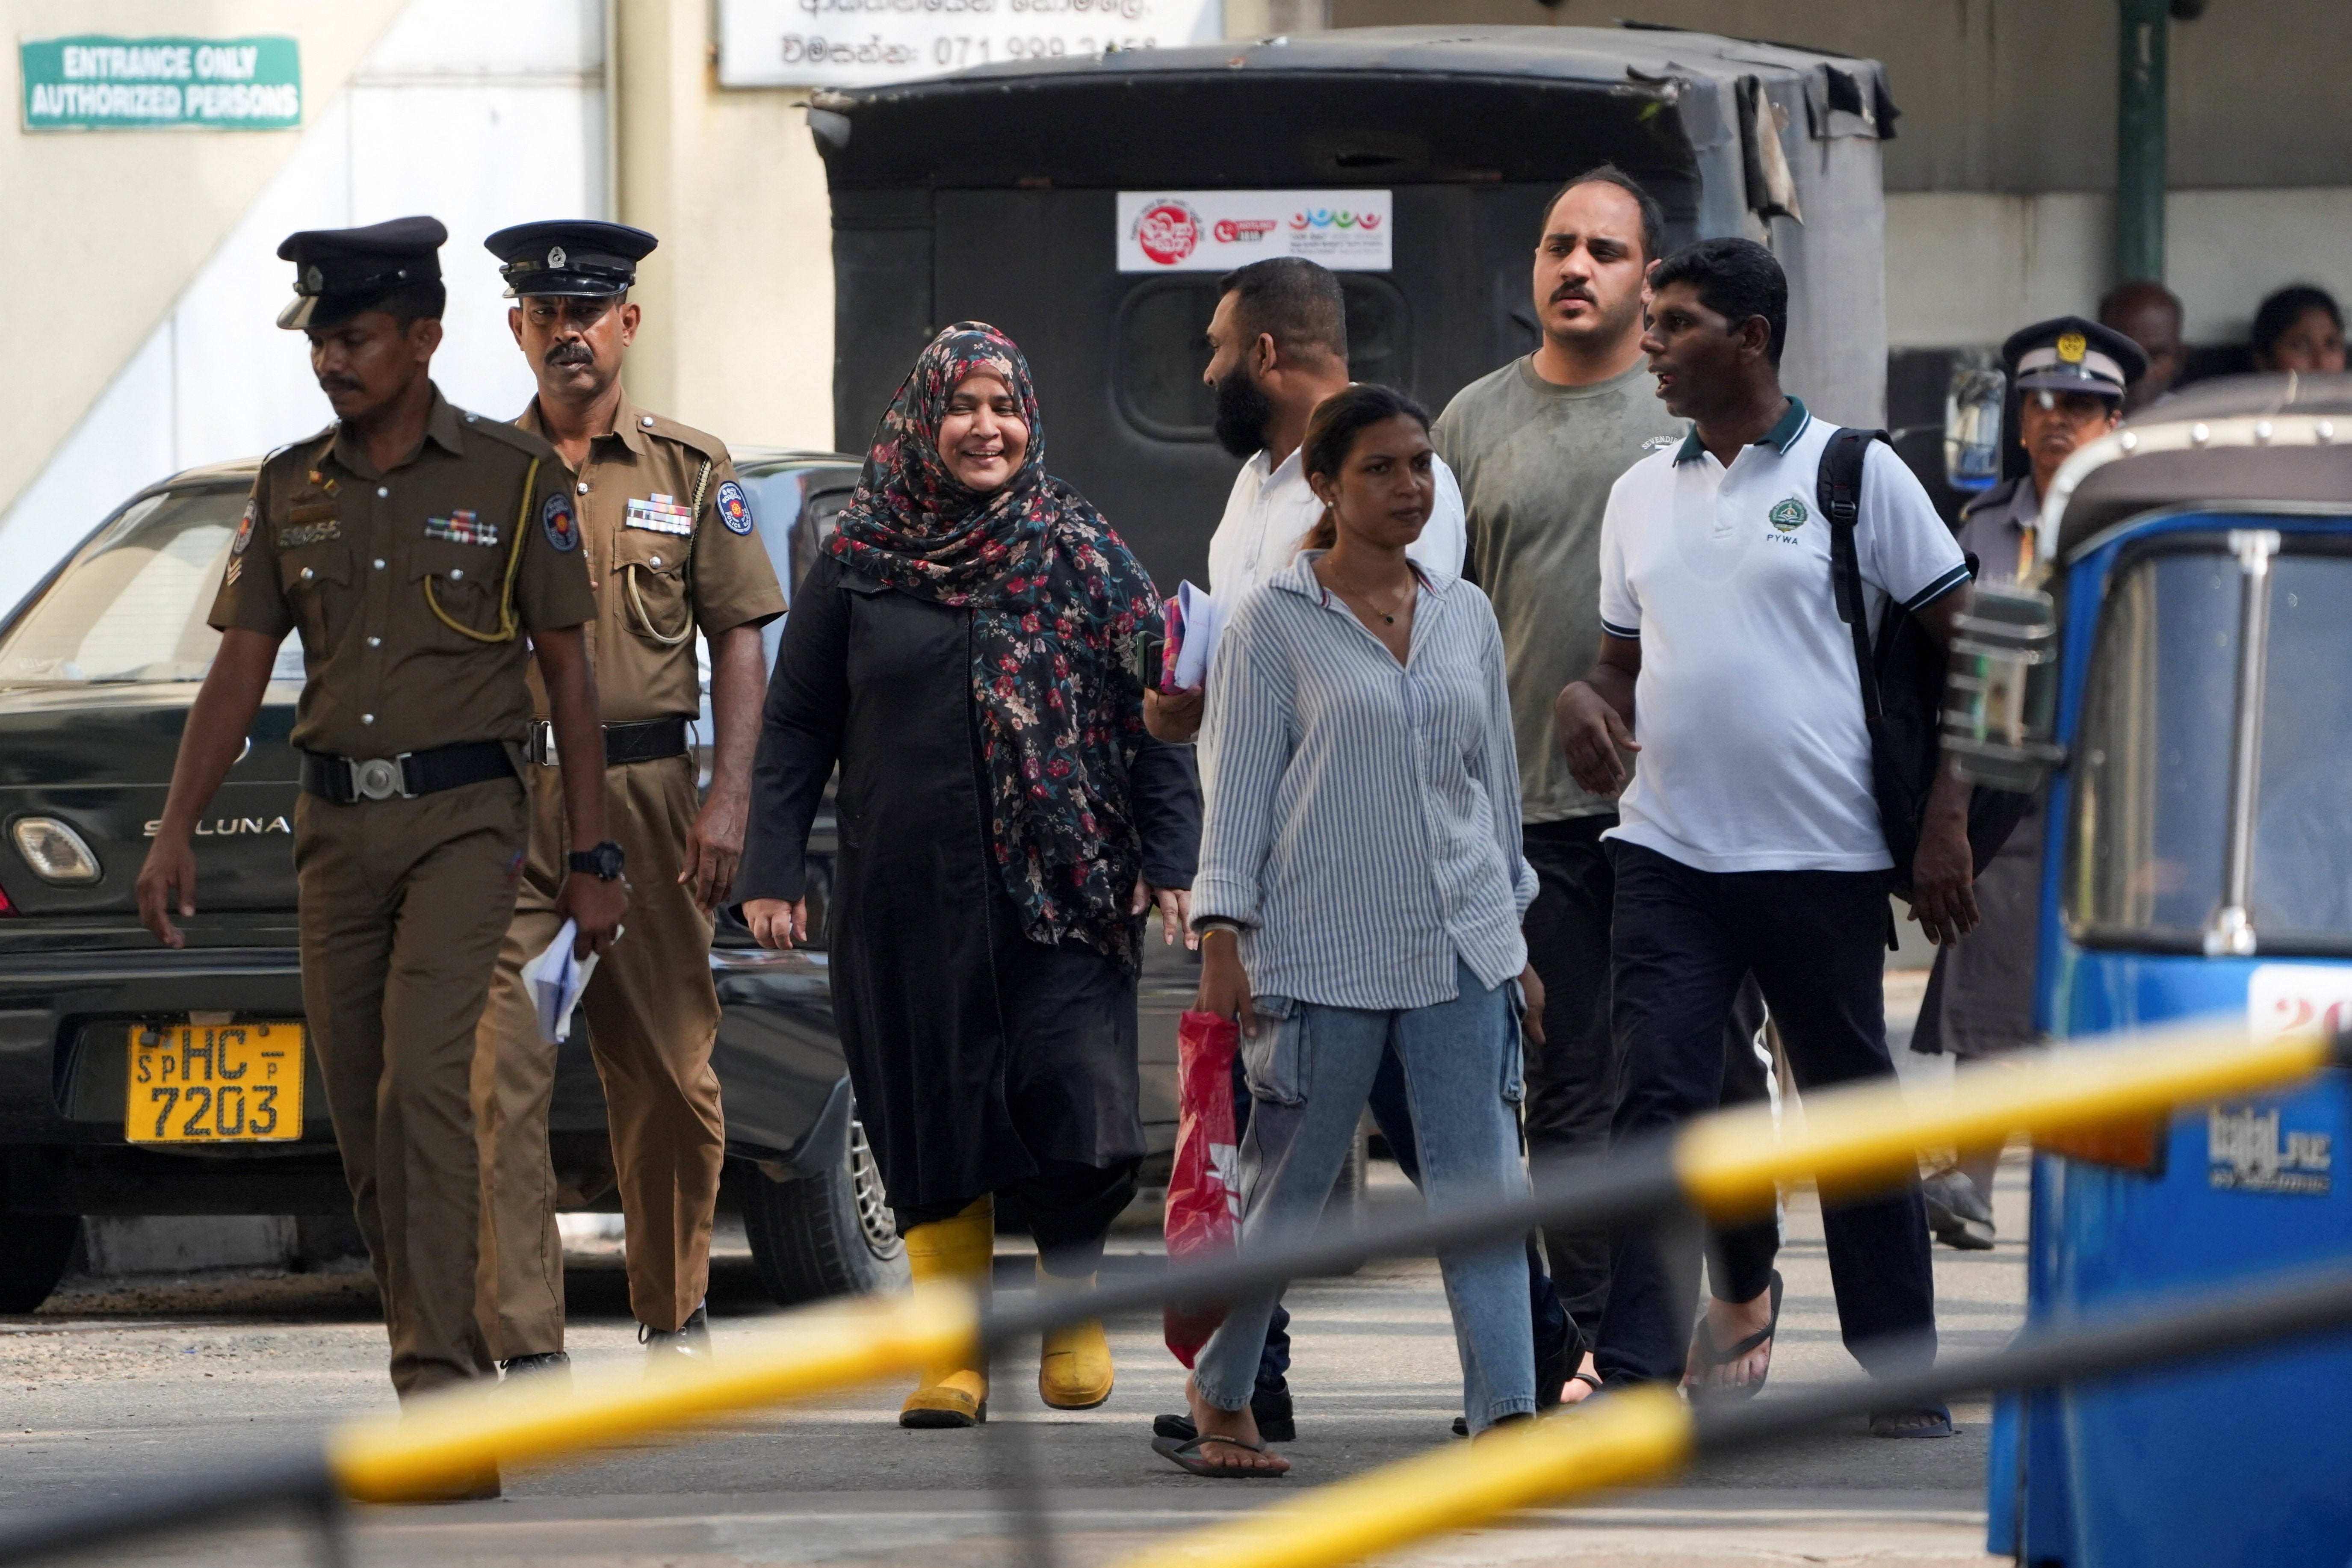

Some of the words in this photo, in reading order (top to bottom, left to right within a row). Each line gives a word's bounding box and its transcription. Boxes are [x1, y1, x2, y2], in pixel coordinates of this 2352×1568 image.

[63, 45, 192, 79] ENTRANCE
[195, 45, 257, 79] ONLY
[31, 83, 182, 116] AUTHORIZED
[185, 83, 298, 118] PERSONS
[725, 511, 741, 528] POLICE
[1767, 534, 1798, 545] PYWA
[143, 816, 292, 836] SLUNA
[151, 1085, 278, 1137] 7203
